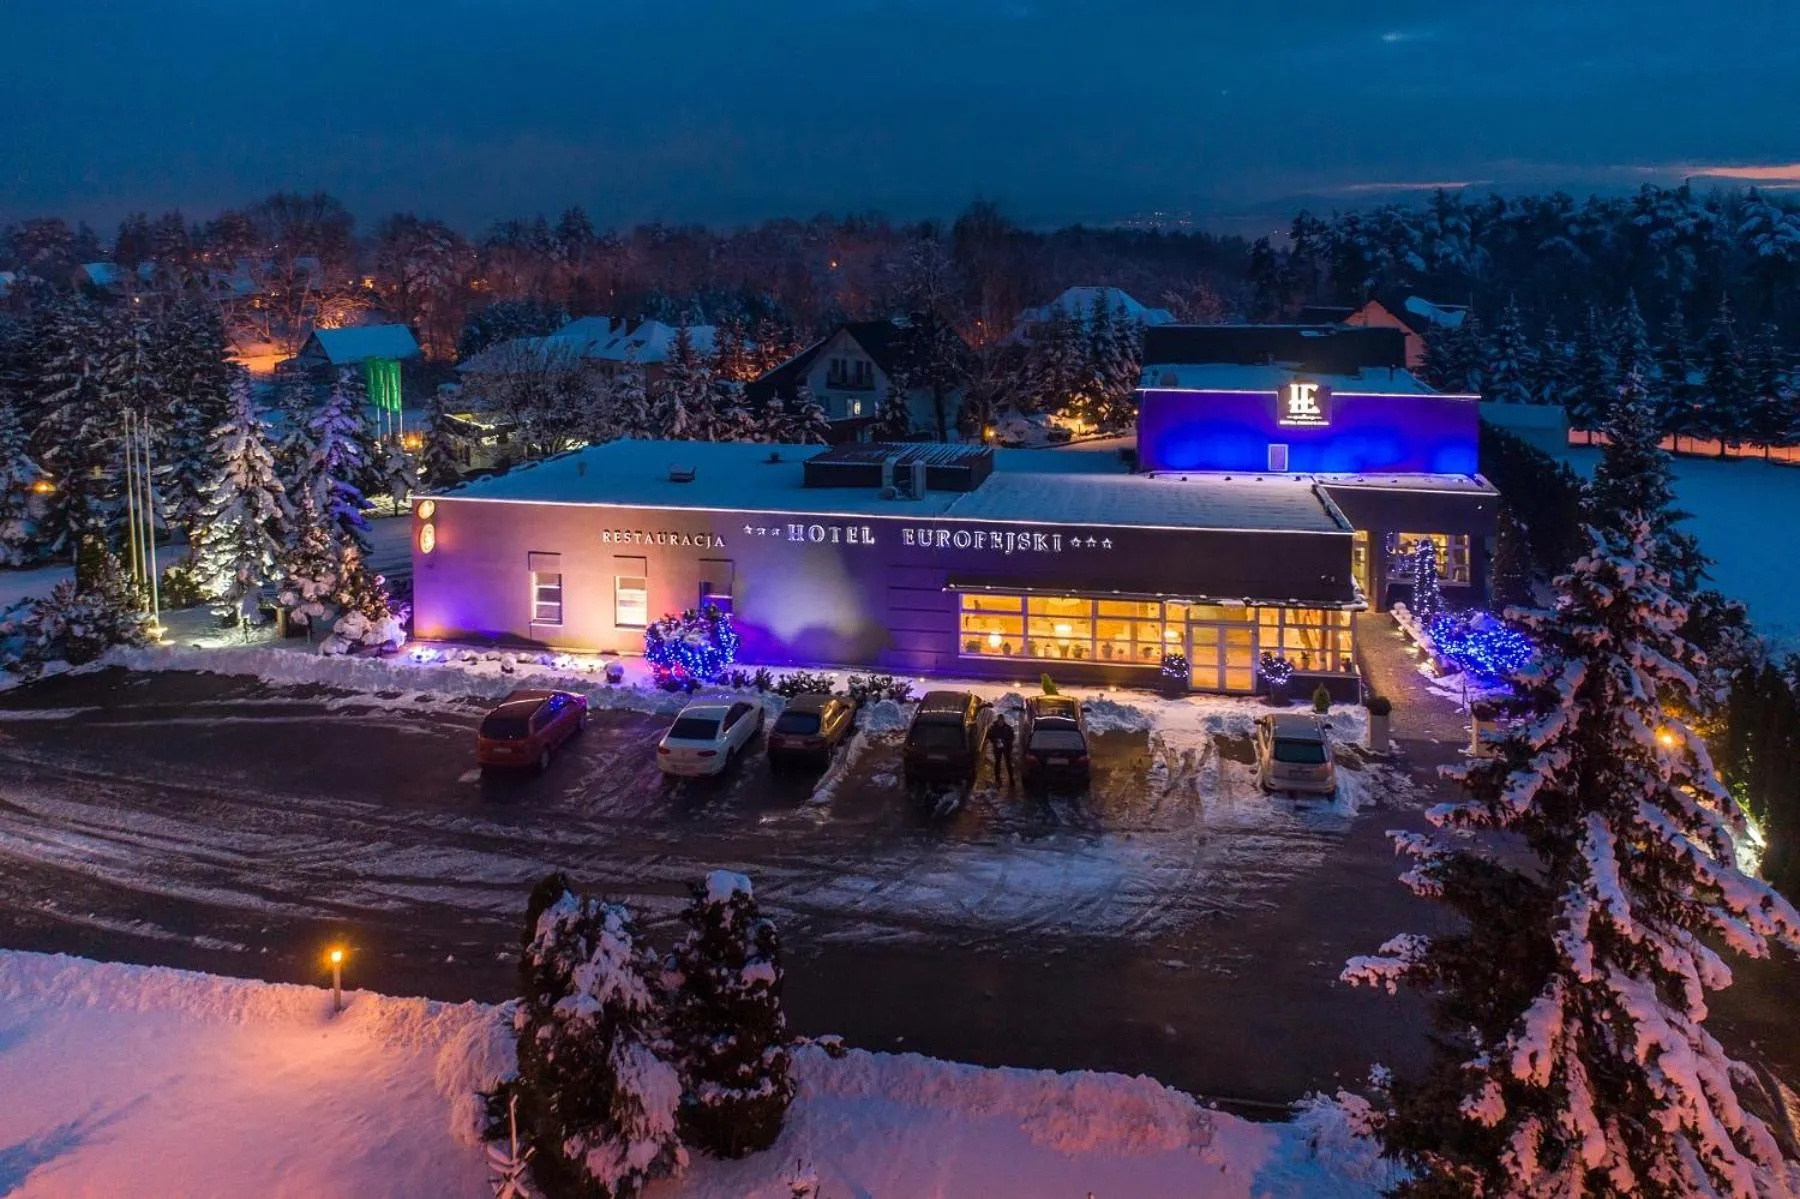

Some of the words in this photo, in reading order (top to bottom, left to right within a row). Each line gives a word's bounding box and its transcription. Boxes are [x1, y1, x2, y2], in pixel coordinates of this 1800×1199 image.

[602, 530, 726, 549] RESTAURACJA
[786, 523, 874, 545] HOTEL
[901, 527, 1062, 553] EUROPEJSKI
